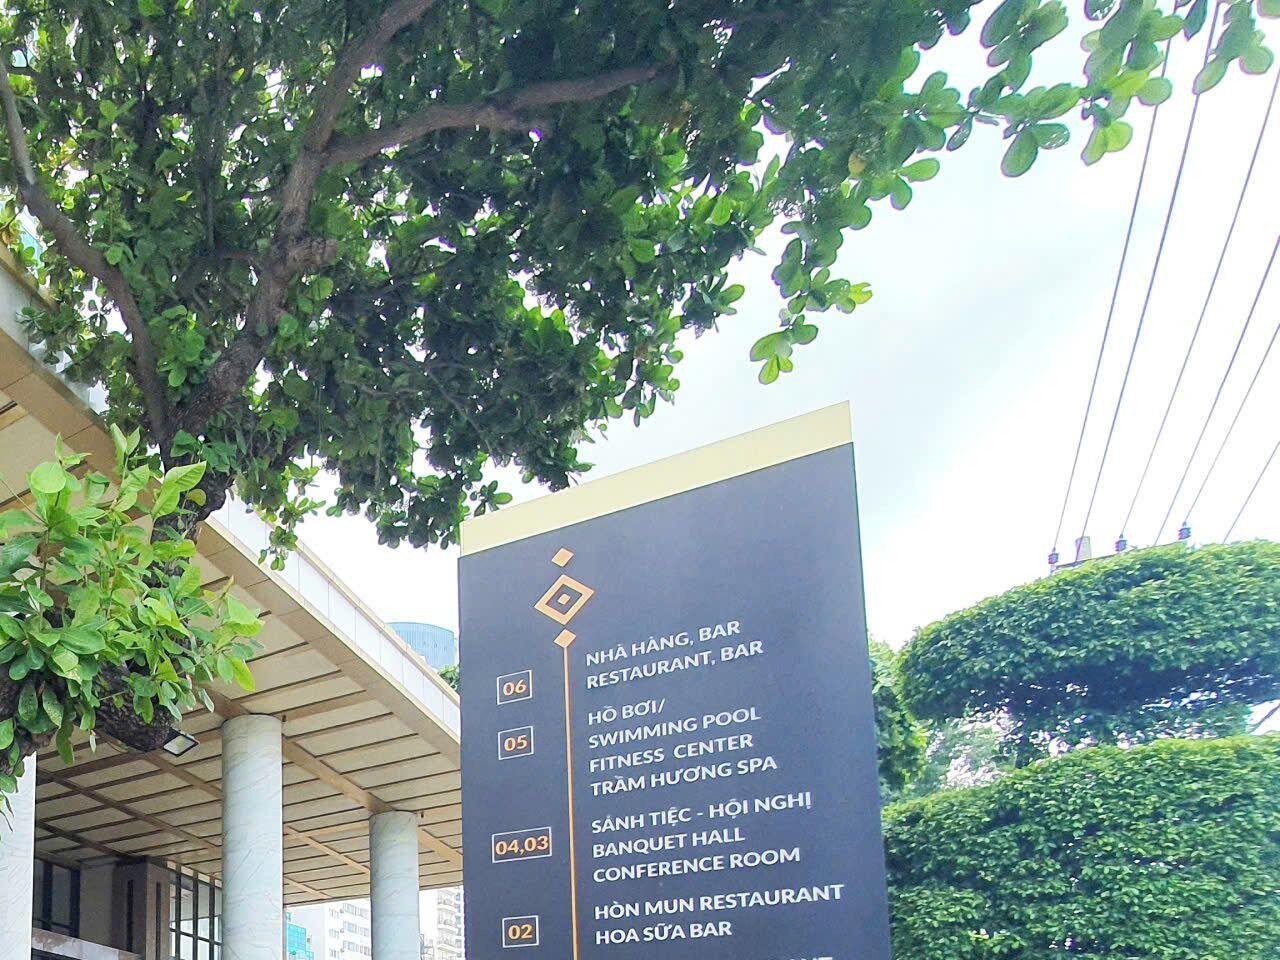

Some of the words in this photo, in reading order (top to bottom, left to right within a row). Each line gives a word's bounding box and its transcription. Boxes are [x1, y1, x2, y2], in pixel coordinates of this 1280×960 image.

[586, 643, 628, 666] NHÀ
[699, 620, 741, 642] BAR
[586, 650, 716, 689] RESTAURANT,
[720, 640, 764, 662] BAR
[503, 679, 527, 697] 06
[503, 734, 528, 752] 05
[588, 717, 698, 749] SWIMMING
[702, 706, 762, 729] POOL
[589, 747, 665, 773] FITNESS
[673, 733, 755, 759] CENTER
[590, 774, 646, 796] TRẦM
[650, 762, 733, 788] HƯƠNG
[736, 755, 779, 775] SPA
[591, 813, 645, 834] SẢNH
[648, 806, 692, 827] TIỆC
[708, 797, 749, 820] HỘI
[754, 791, 813, 810] NGHỊ
[495, 834, 550, 857] 04,03
[592, 833, 688, 859] BANQUET
[692, 827, 746, 847] HALL
[593, 855, 725, 883] CONFERENCE
[729, 847, 801, 869] ROOM
[594, 900, 640, 920] HÒN
[644, 897, 695, 916] MUN
[699, 884, 846, 911] RESTAURANT
[508, 923, 533, 941] 02
[595, 928, 641, 945] HOA
[642, 922, 687, 942] SỮA
[689, 920, 733, 939] BAR
